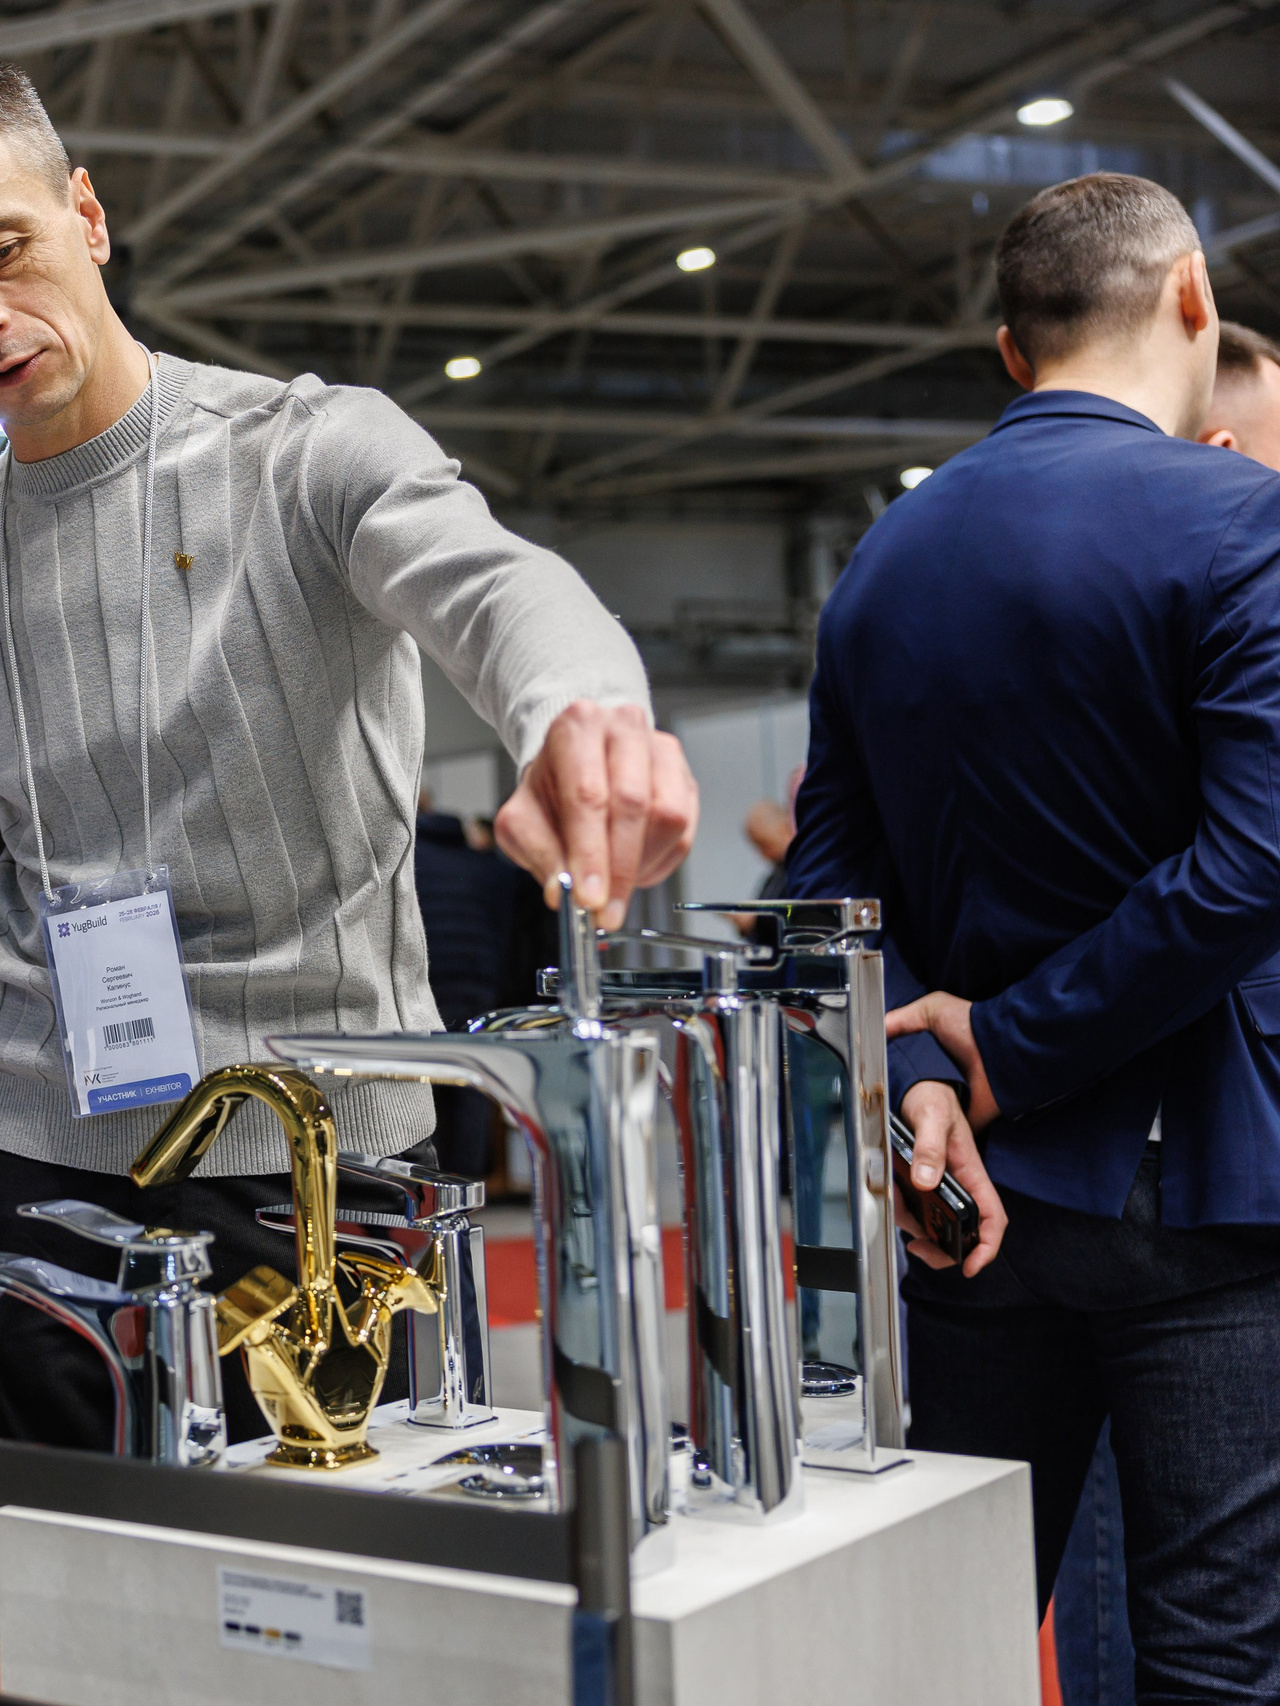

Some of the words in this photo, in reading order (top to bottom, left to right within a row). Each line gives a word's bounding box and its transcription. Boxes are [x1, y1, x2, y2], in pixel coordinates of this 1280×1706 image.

[133, 904, 158, 913] ФЕВРАЛЯ
[119, 913, 145, 923] FEBRUARY
[71, 915, 108, 933] YugBuild
[106, 965, 126, 973] Роман
[102, 973, 133, 983] Сергеевич
[97, 1090, 136, 1103] УЧАСТНИК
[145, 1081, 182, 1095] EXHIBITOR
